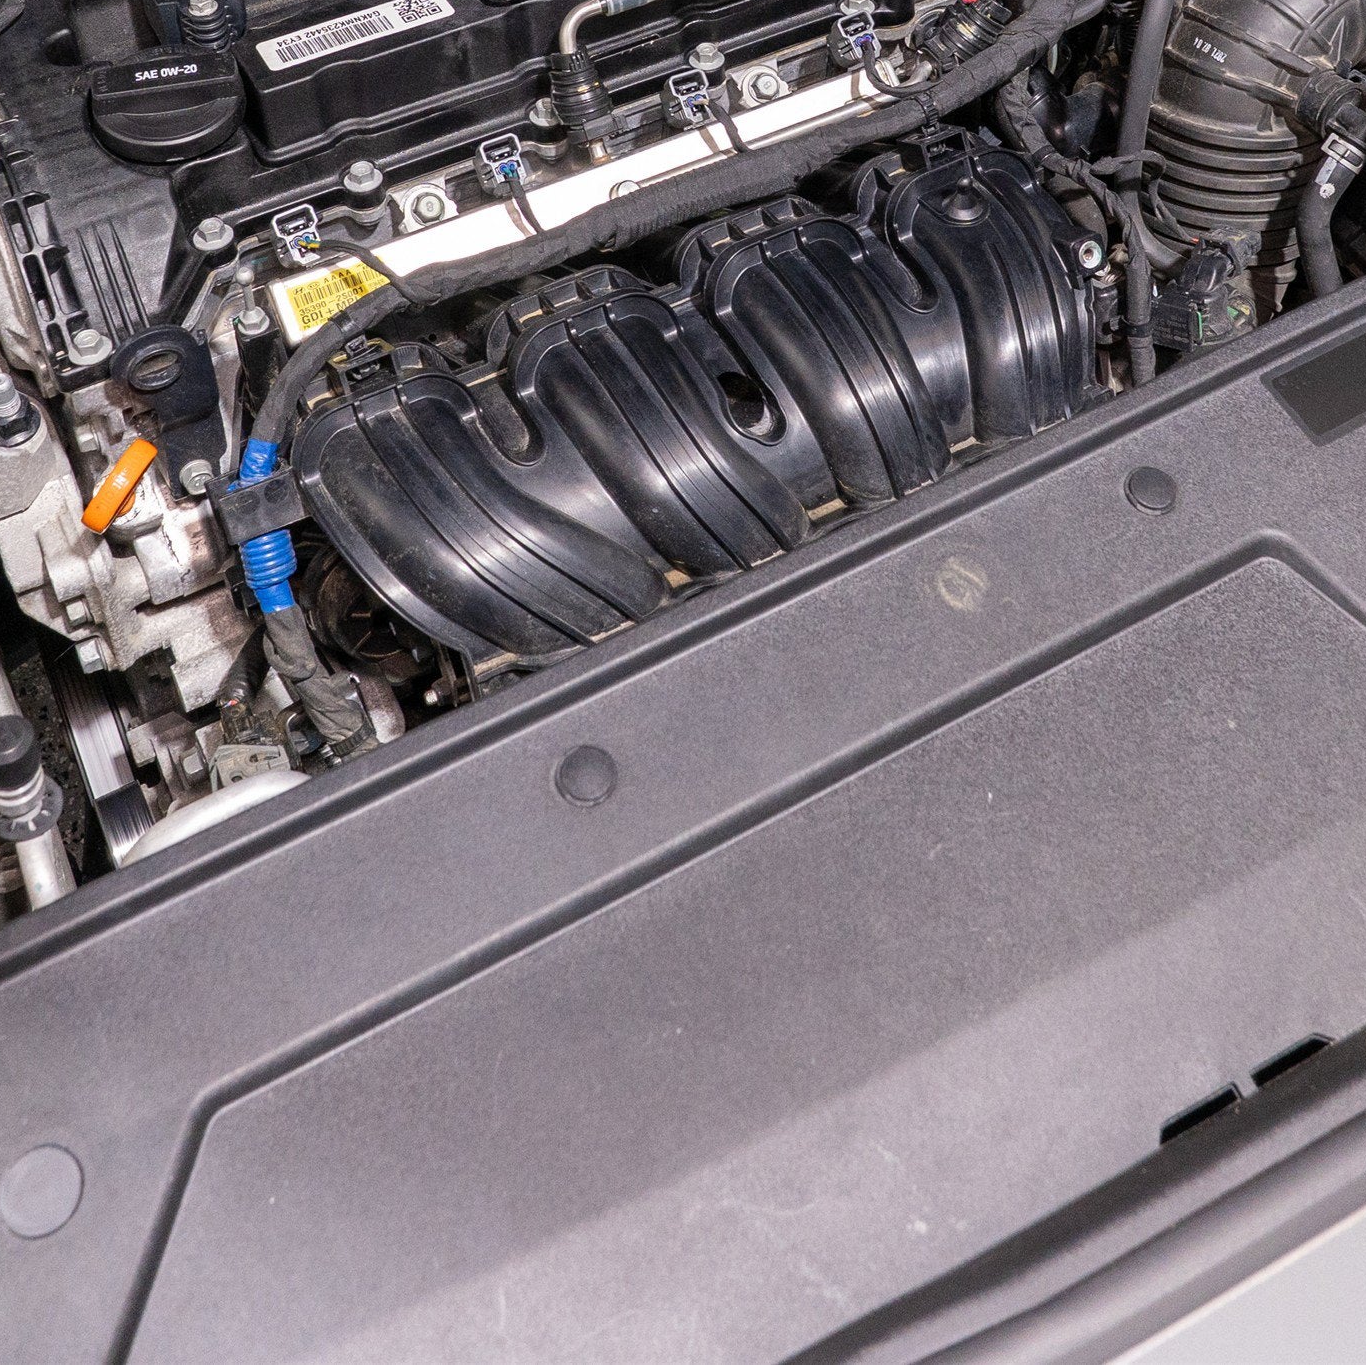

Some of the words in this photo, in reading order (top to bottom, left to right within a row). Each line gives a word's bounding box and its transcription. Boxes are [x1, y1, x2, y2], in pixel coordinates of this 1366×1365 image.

[302, 8, 381, 39] G4KNMK235442
[275, 33, 302, 48] EY34
[134, 68, 158, 81] SAE
[159, 63, 197, 77] 0W-20
[298, 299, 327, 316] 35390
[335, 286, 364, 302] 2S001
[300, 310, 324, 325] GDI
